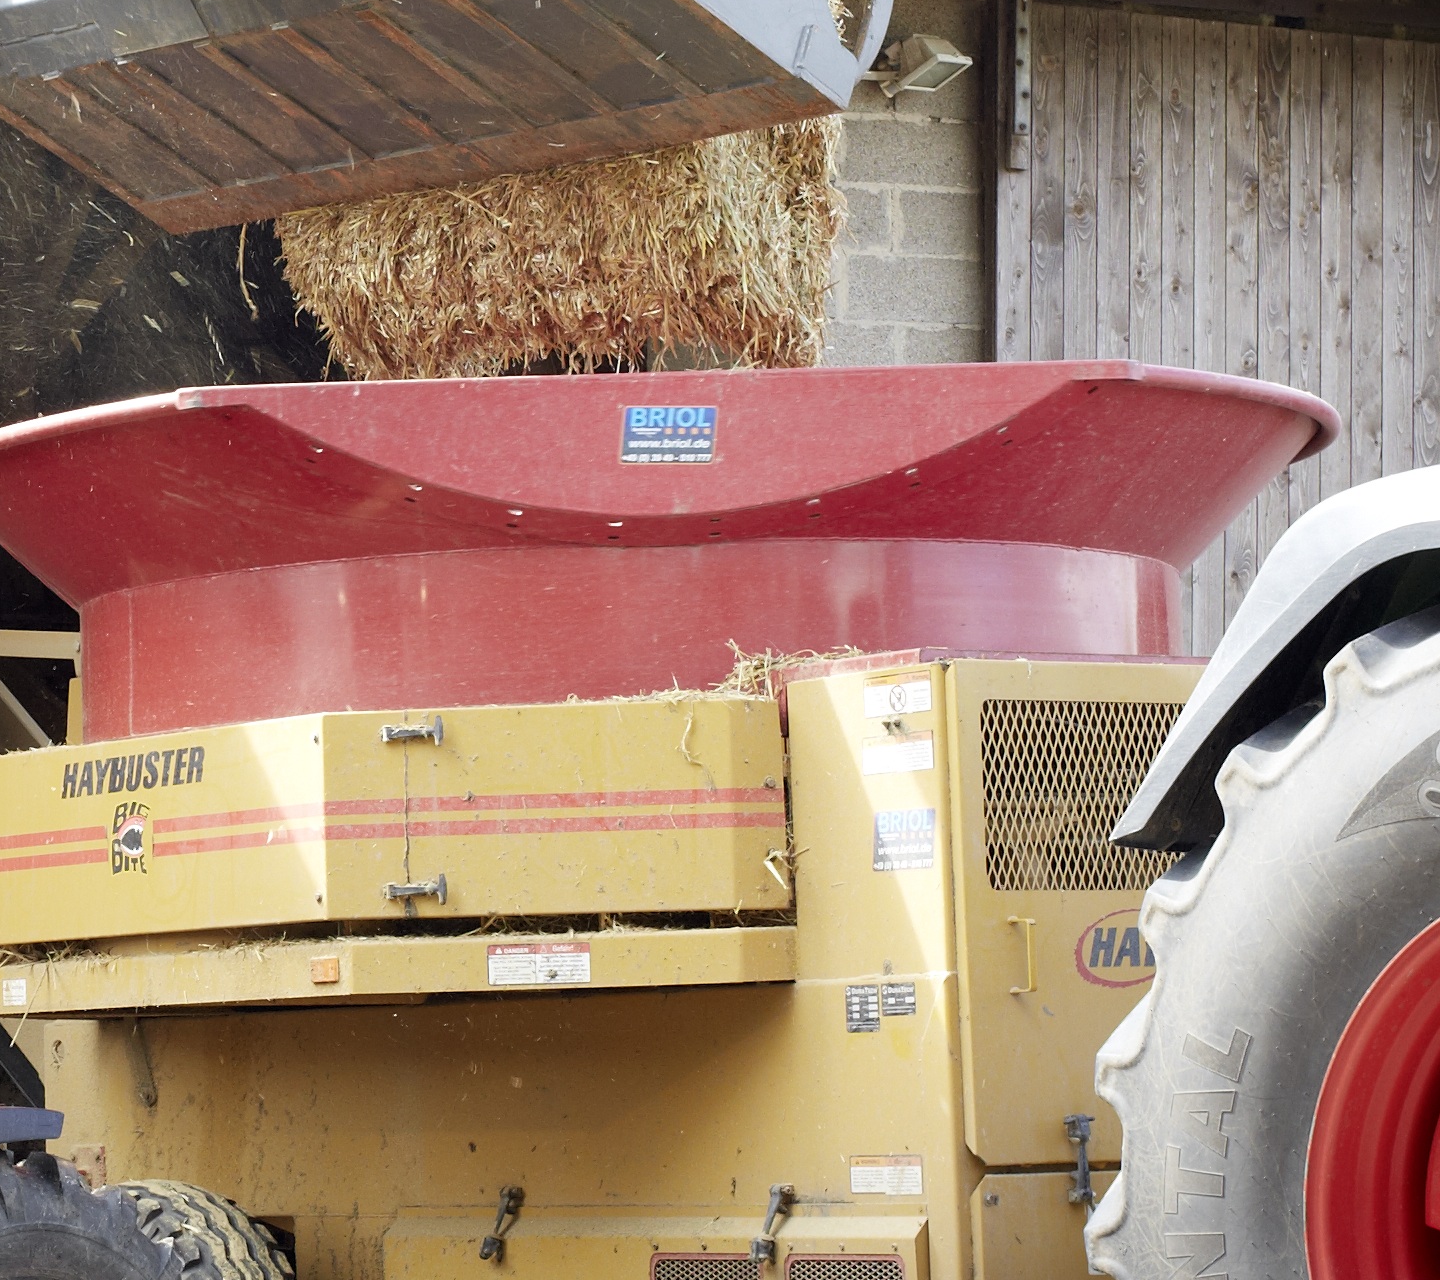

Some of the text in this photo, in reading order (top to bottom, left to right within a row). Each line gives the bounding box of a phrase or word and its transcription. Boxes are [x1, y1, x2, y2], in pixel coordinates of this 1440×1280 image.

[631, 408, 711, 427] BRIOL
[628, 439, 711, 448] www.briol.de
[61, 746, 205, 799] HAYBUSTER
[112, 801, 151, 834] BIG
[878, 810, 931, 833] BRIOL
[111, 838, 147, 875] BITE
